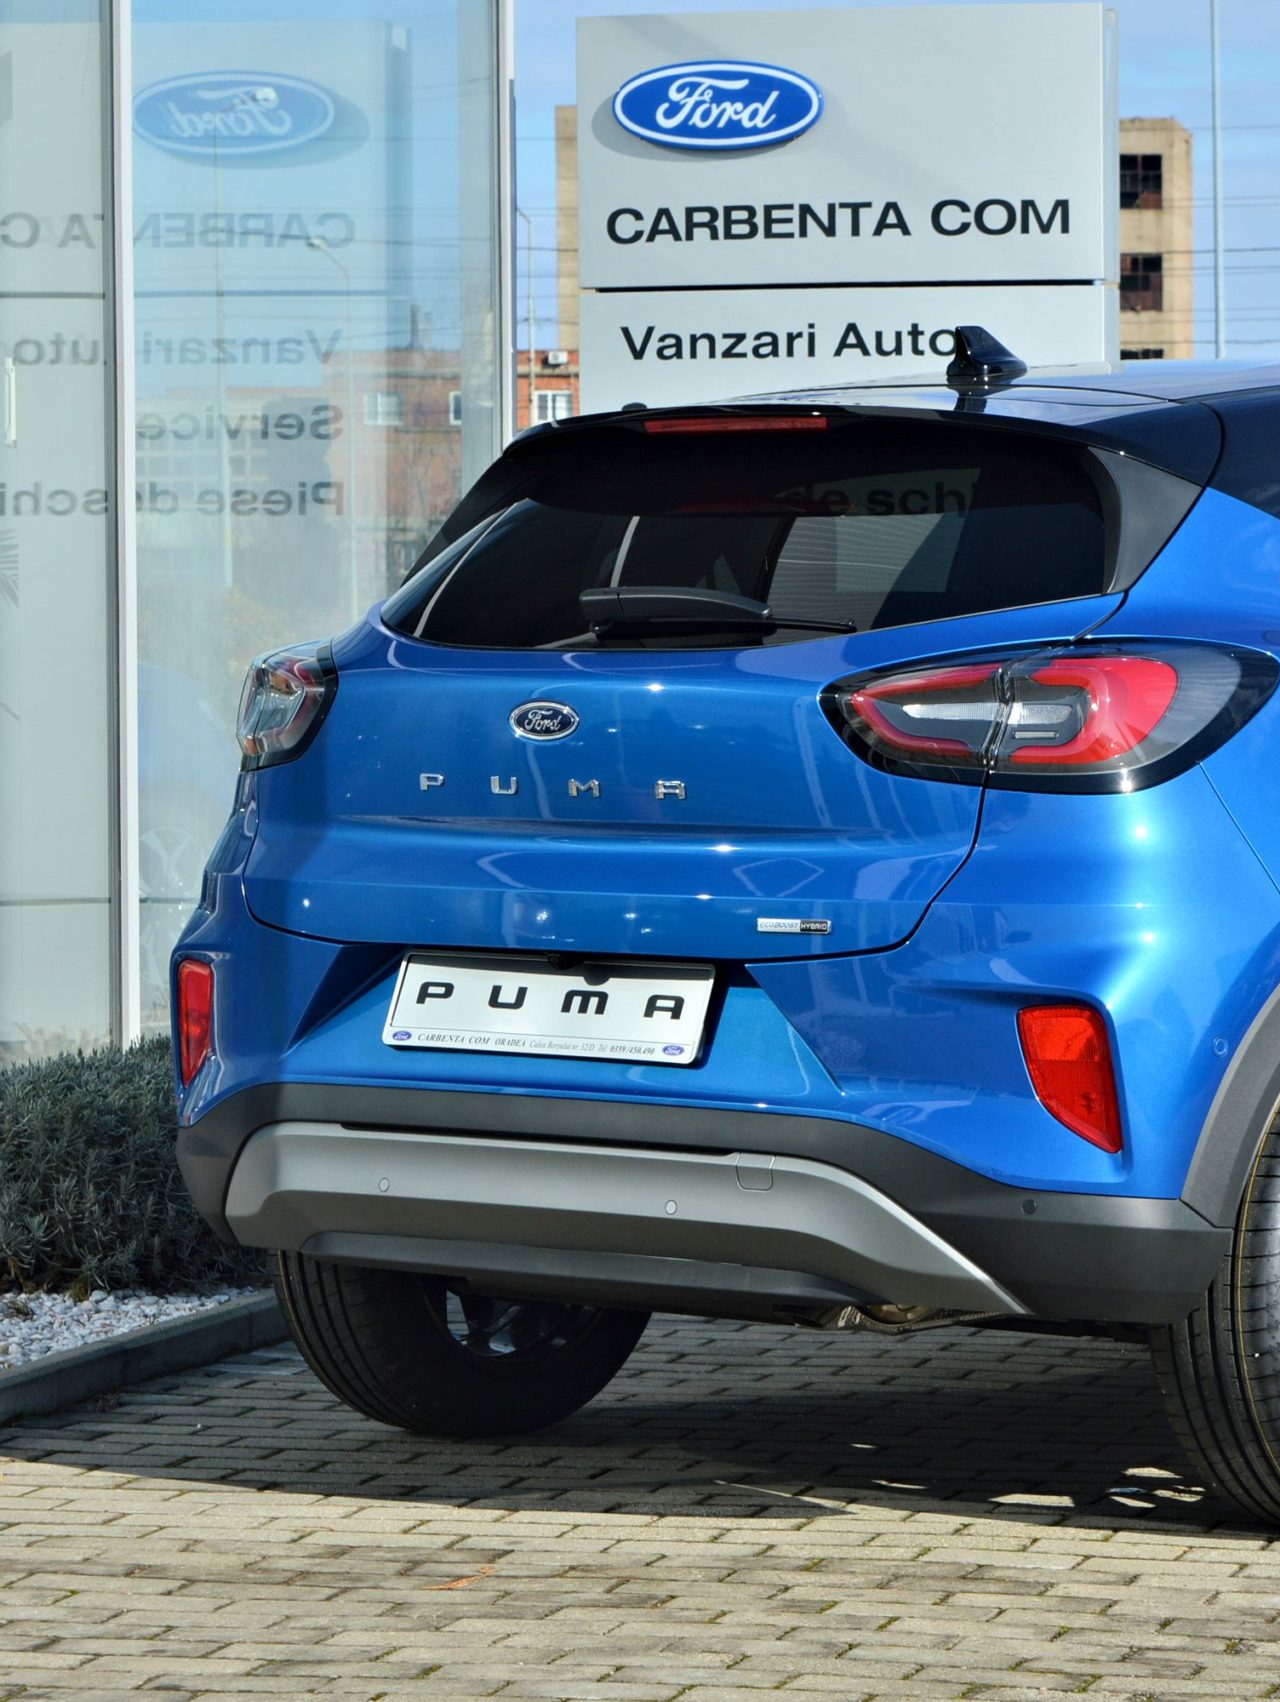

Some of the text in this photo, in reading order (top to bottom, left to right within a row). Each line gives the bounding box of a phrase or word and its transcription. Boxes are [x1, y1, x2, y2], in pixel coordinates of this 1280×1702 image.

[655, 76, 780, 130] Ford
[606, 198, 1071, 245] CARBENTA COM
[620, 321, 957, 361] Vanzari Auto
[523, 708, 563, 733] Ford
[419, 772, 688, 801] PUMA
[800, 922, 828, 931] HYBRID
[415, 981, 686, 1021] PUMA
[417, 1033, 465, 1044] CARBENTA
[468, 1036, 490, 1045] COM
[494, 1038, 526, 1048] ORADEA
